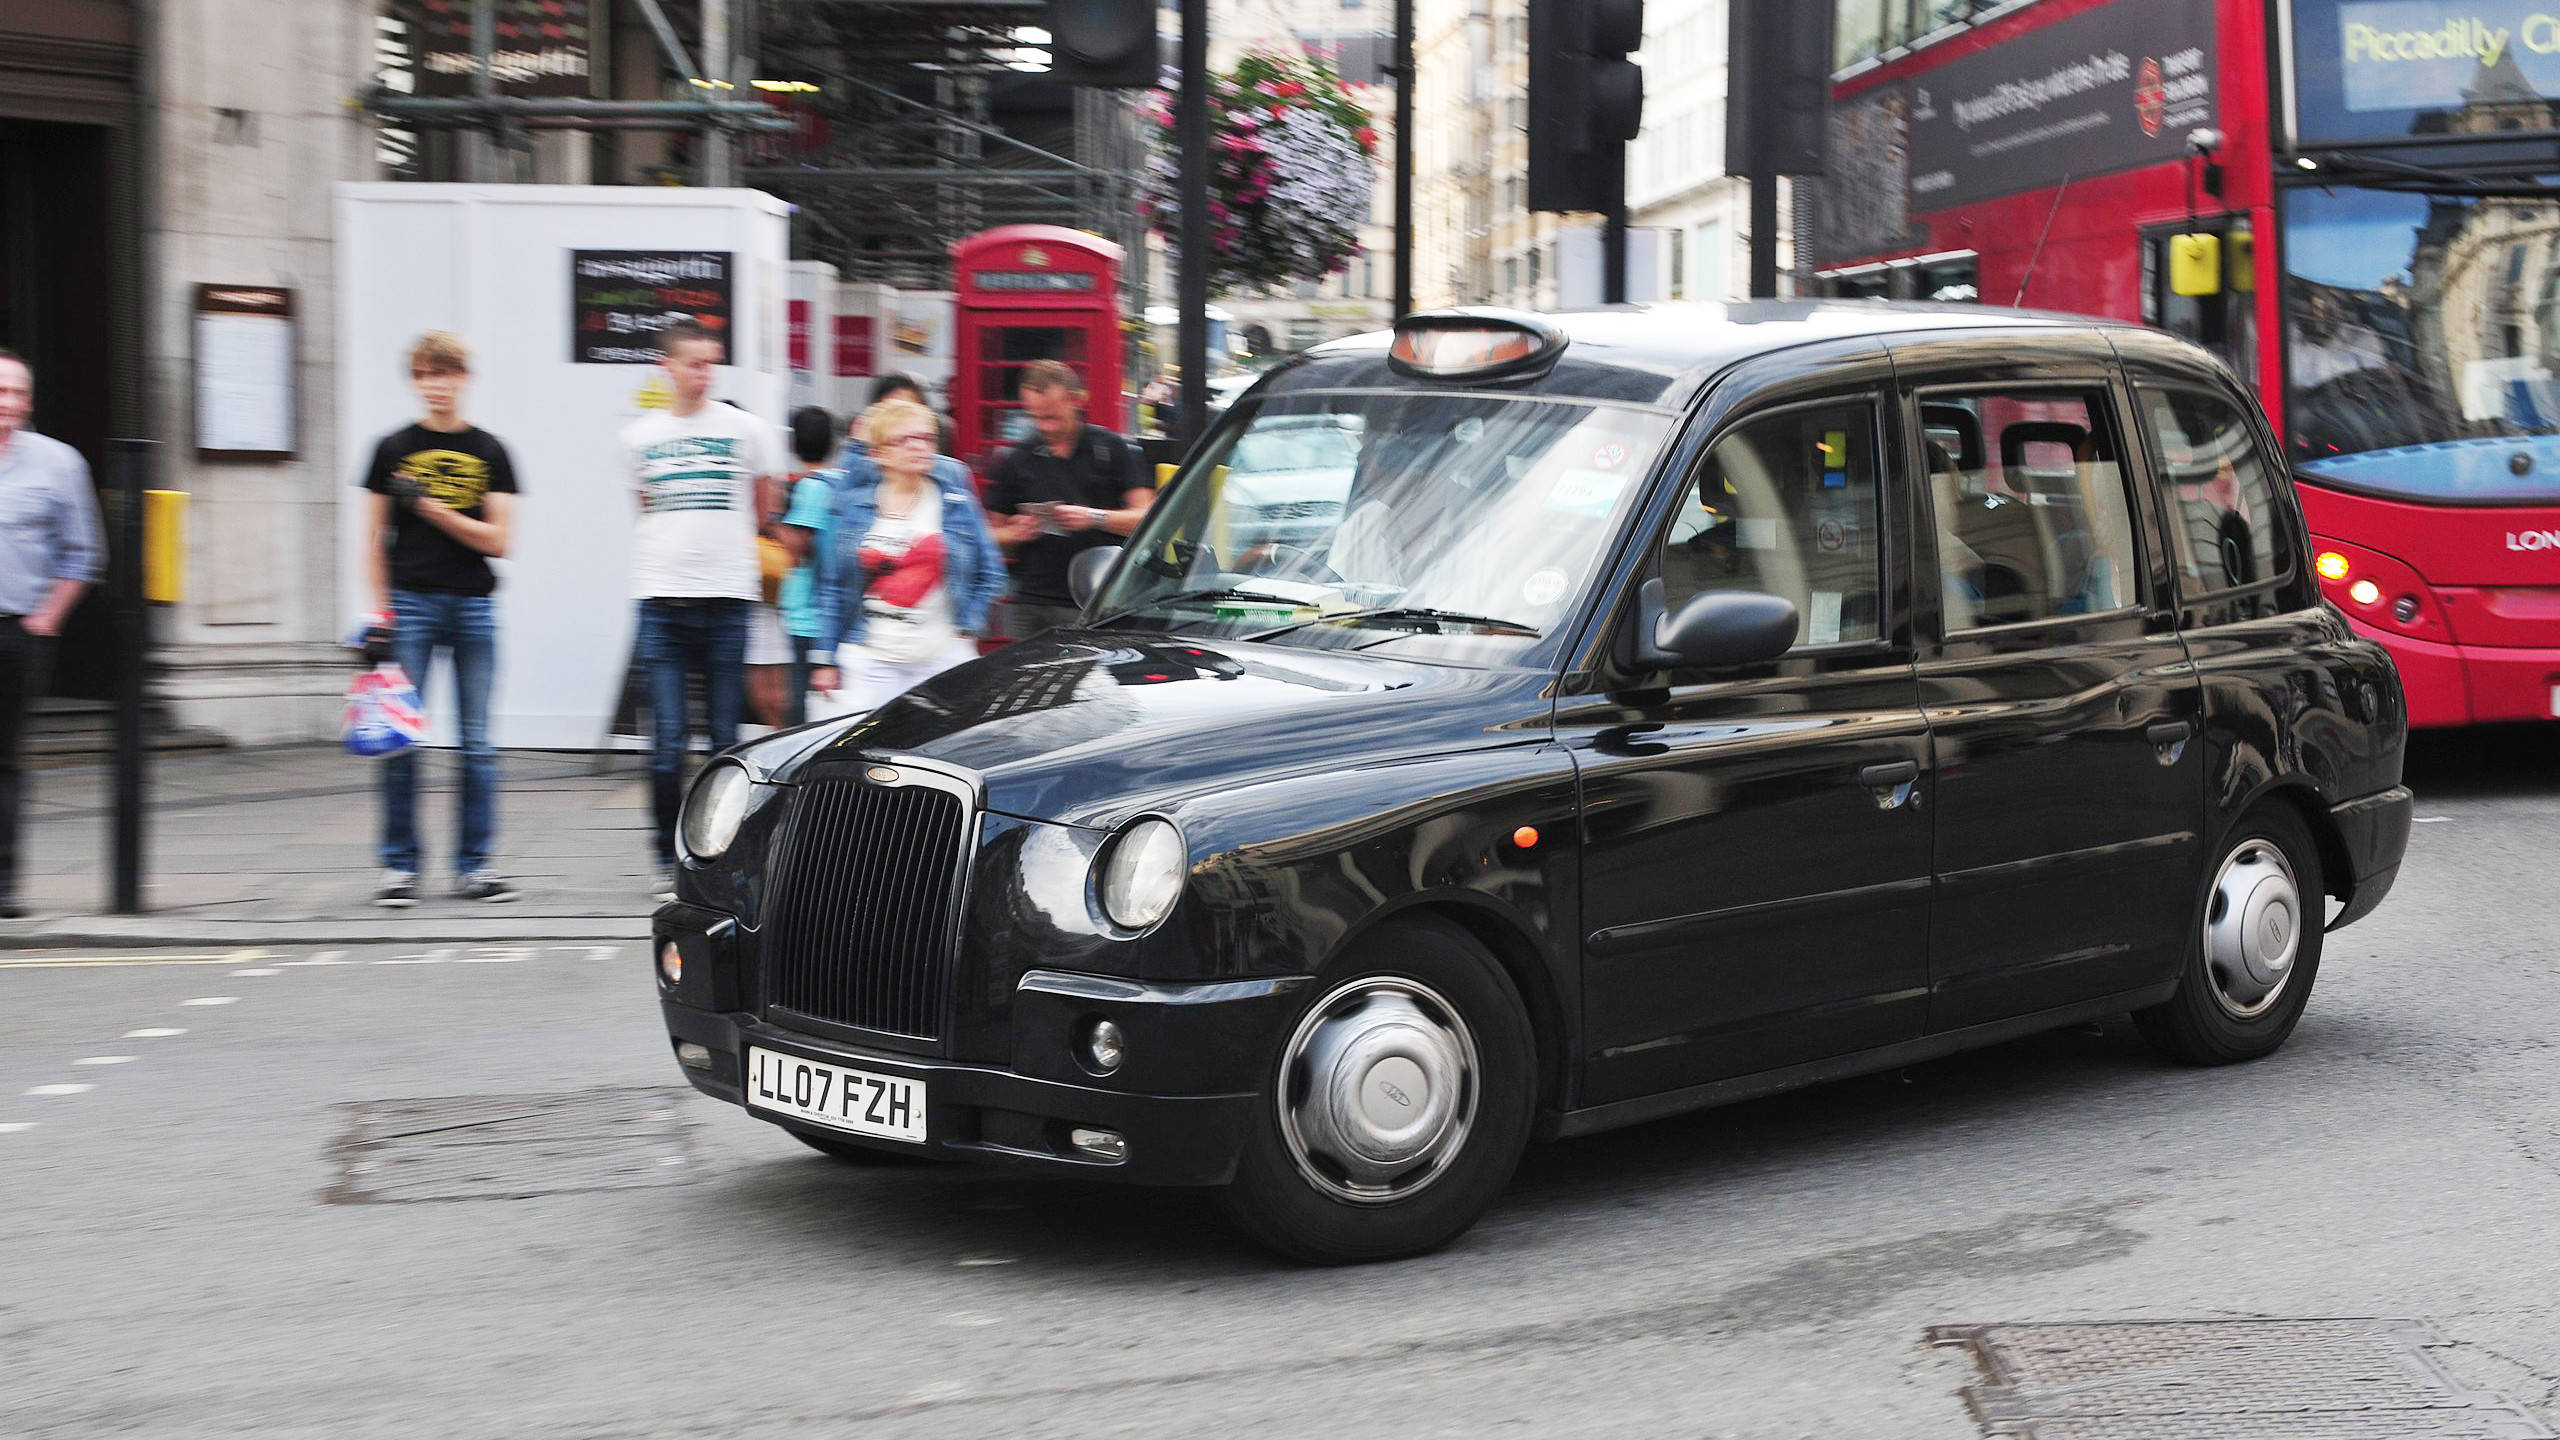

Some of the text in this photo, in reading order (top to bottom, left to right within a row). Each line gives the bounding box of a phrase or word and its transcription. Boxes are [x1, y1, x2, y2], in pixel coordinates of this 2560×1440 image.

[2344, 17, 2510, 67] Piccadilly
[760, 1054, 911, 1129] LL07 FZH
